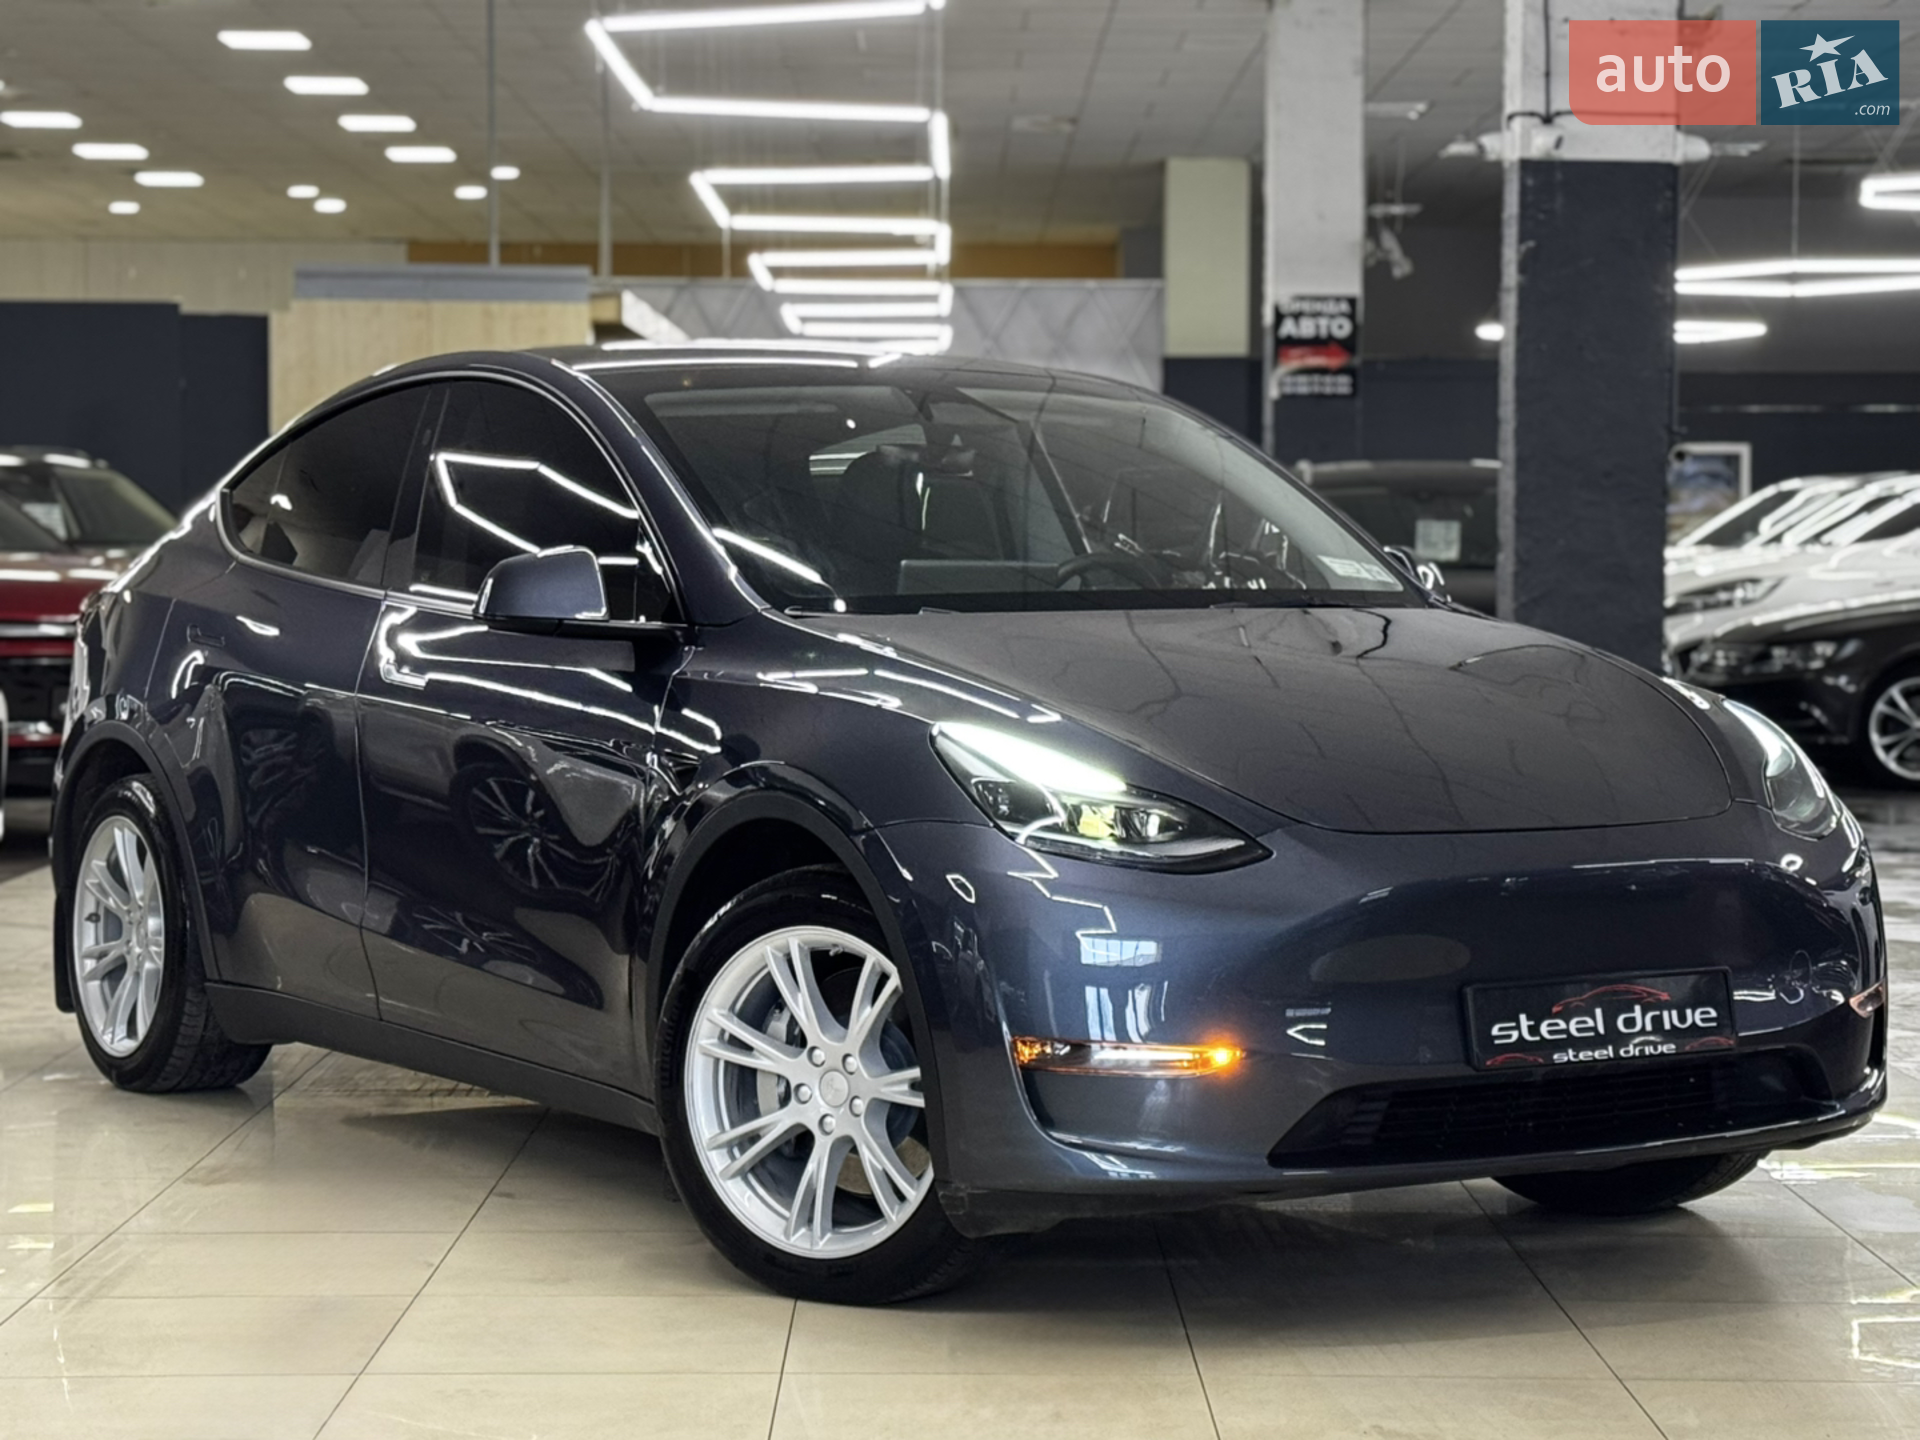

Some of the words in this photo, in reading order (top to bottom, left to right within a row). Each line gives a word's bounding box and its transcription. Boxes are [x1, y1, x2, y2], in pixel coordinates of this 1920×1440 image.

[1277, 316, 1353, 339] АВТО
[1491, 1007, 1605, 1044] steel
[1616, 1004, 1718, 1034] drive
[1552, 1045, 1613, 1064] steel
[1619, 1042, 1676, 1057] drive
